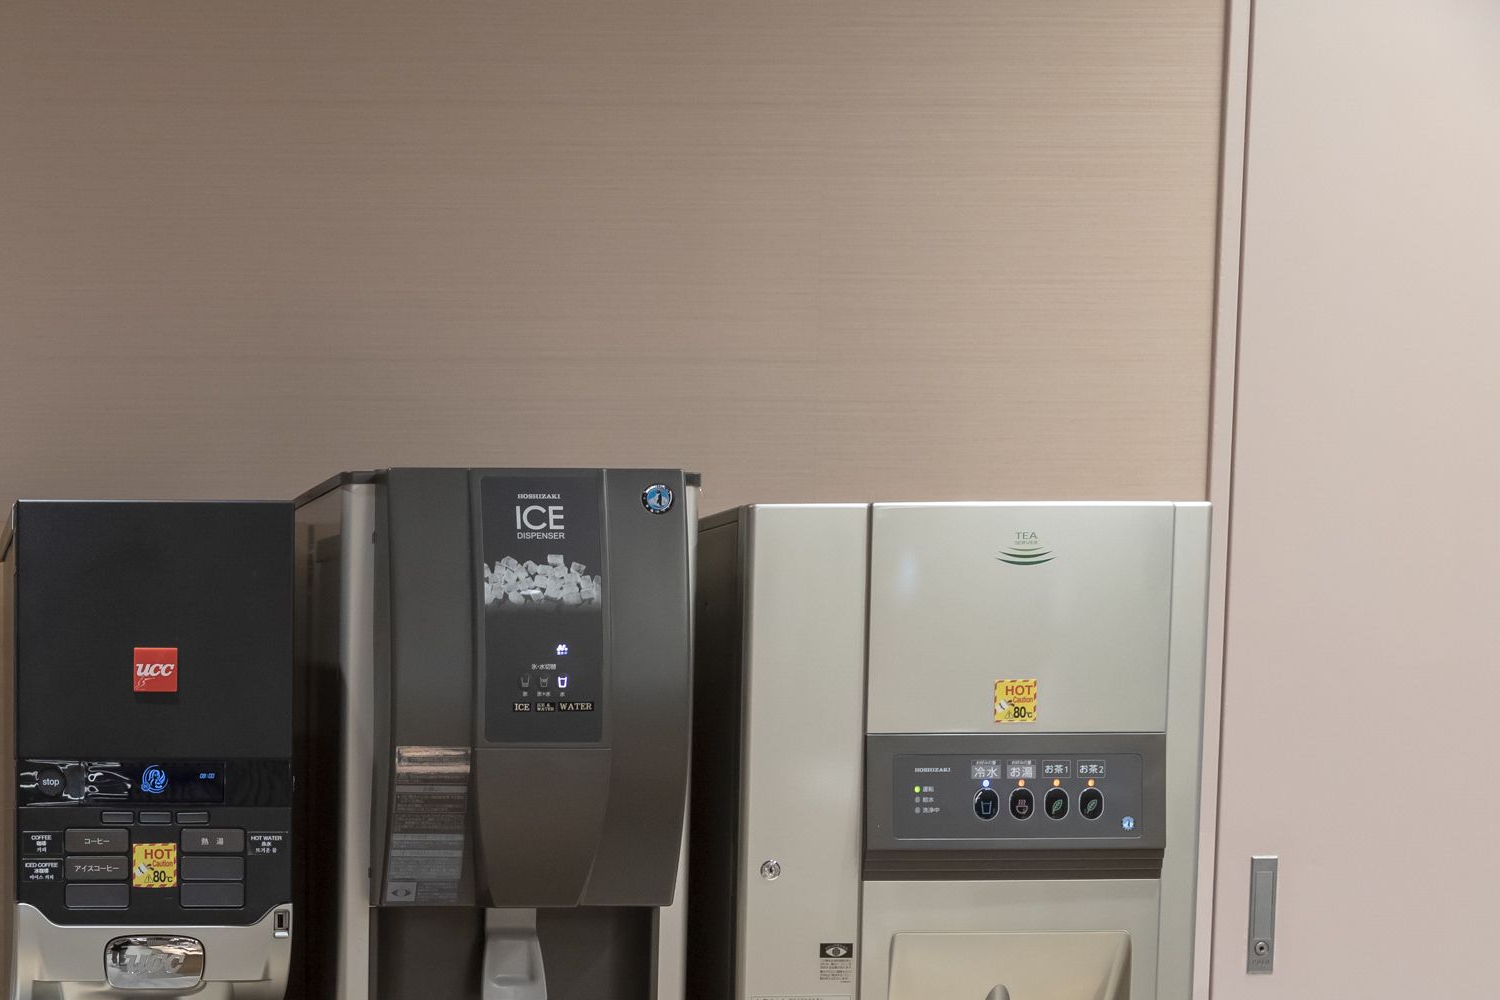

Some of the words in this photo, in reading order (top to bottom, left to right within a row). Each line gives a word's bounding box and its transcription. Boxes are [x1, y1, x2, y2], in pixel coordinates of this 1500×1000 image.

[515, 505, 564, 530] ICE
[1005, 685, 1033, 696] HOT
[514, 703, 530, 711] ICE
[974, 767, 998, 778] 冷水
[1010, 767, 1033, 778] お湯
[1044, 765, 1069, 774] お茶1
[1079, 765, 1104, 774] お茶2
[42, 778, 60, 787] stop
[144, 849, 173, 859] HOT
